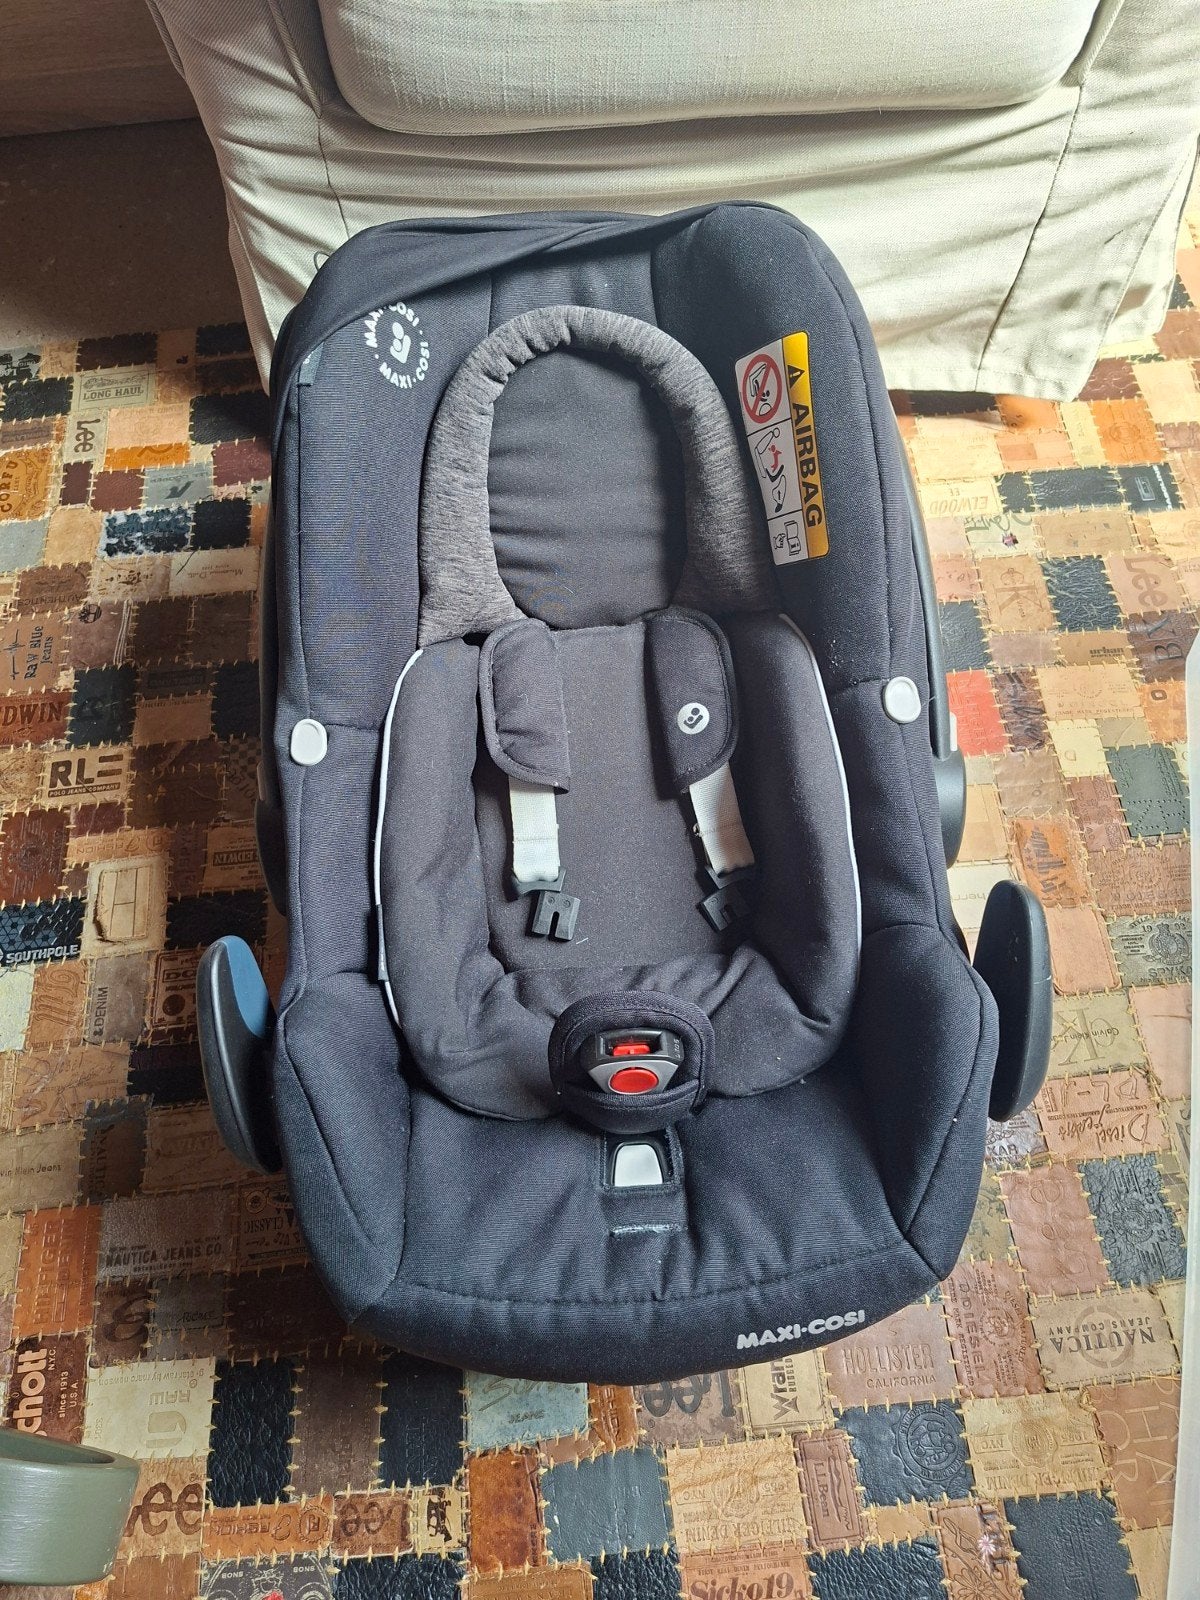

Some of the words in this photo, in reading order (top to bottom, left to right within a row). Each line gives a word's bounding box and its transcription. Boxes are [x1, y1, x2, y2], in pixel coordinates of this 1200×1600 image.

[83, 388, 112, 400] LONG
[114, 386, 145, 399] HAUL
[74, 418, 101, 453] Lee
[791, 402, 823, 528] AIRBAG
[929, 495, 989, 514] ELWOOD
[1123, 556, 1169, 608] Lee
[40, 635, 54, 664] Jeans
[0, 702, 65, 728] DWIN
[49, 787, 67, 798] POLO
[66, 784, 89, 796] JEANS
[90, 782, 121, 794] COMPANY
[5, 944, 80, 964] SOUTHPOLE
[1069, 1031, 1091, 1041] Klein
[1092, 1026, 1120, 1038] Calvin
[37, 1163, 62, 1174] Jeans
[244, 1216, 285, 1235] CLASSIC
[105, 1249, 158, 1269] NAUTICA
[162, 1245, 203, 1262] JEANS
[33, 1221, 58, 1325] HILFIGER
[1049, 1321, 1105, 1336] COMPANY
[1111, 1315, 1152, 1331] JEANS
[953, 1307, 962, 1329] MARK
[959, 1333, 975, 1387] REGISTERED
[1049, 1326, 1156, 1355] NAUTICA
[47, 1346, 57, 1371] N.Y.C.
[842, 1343, 935, 1376] HOLLISTER
[60, 1371, 69, 1393] 1913
[152, 1370, 162, 1382] by
[866, 1374, 937, 1390] CALIFORNIA
[12, 1348, 48, 1437] chott
[69, 1379, 79, 1408] U.S.A.
[148, 1390, 191, 1406] RAW
[58, 1393, 68, 1418] since
[981, 1437, 1004, 1449] NYC
[122, 1482, 203, 1538] ee
[685, 1524, 729, 1543] DENIM
